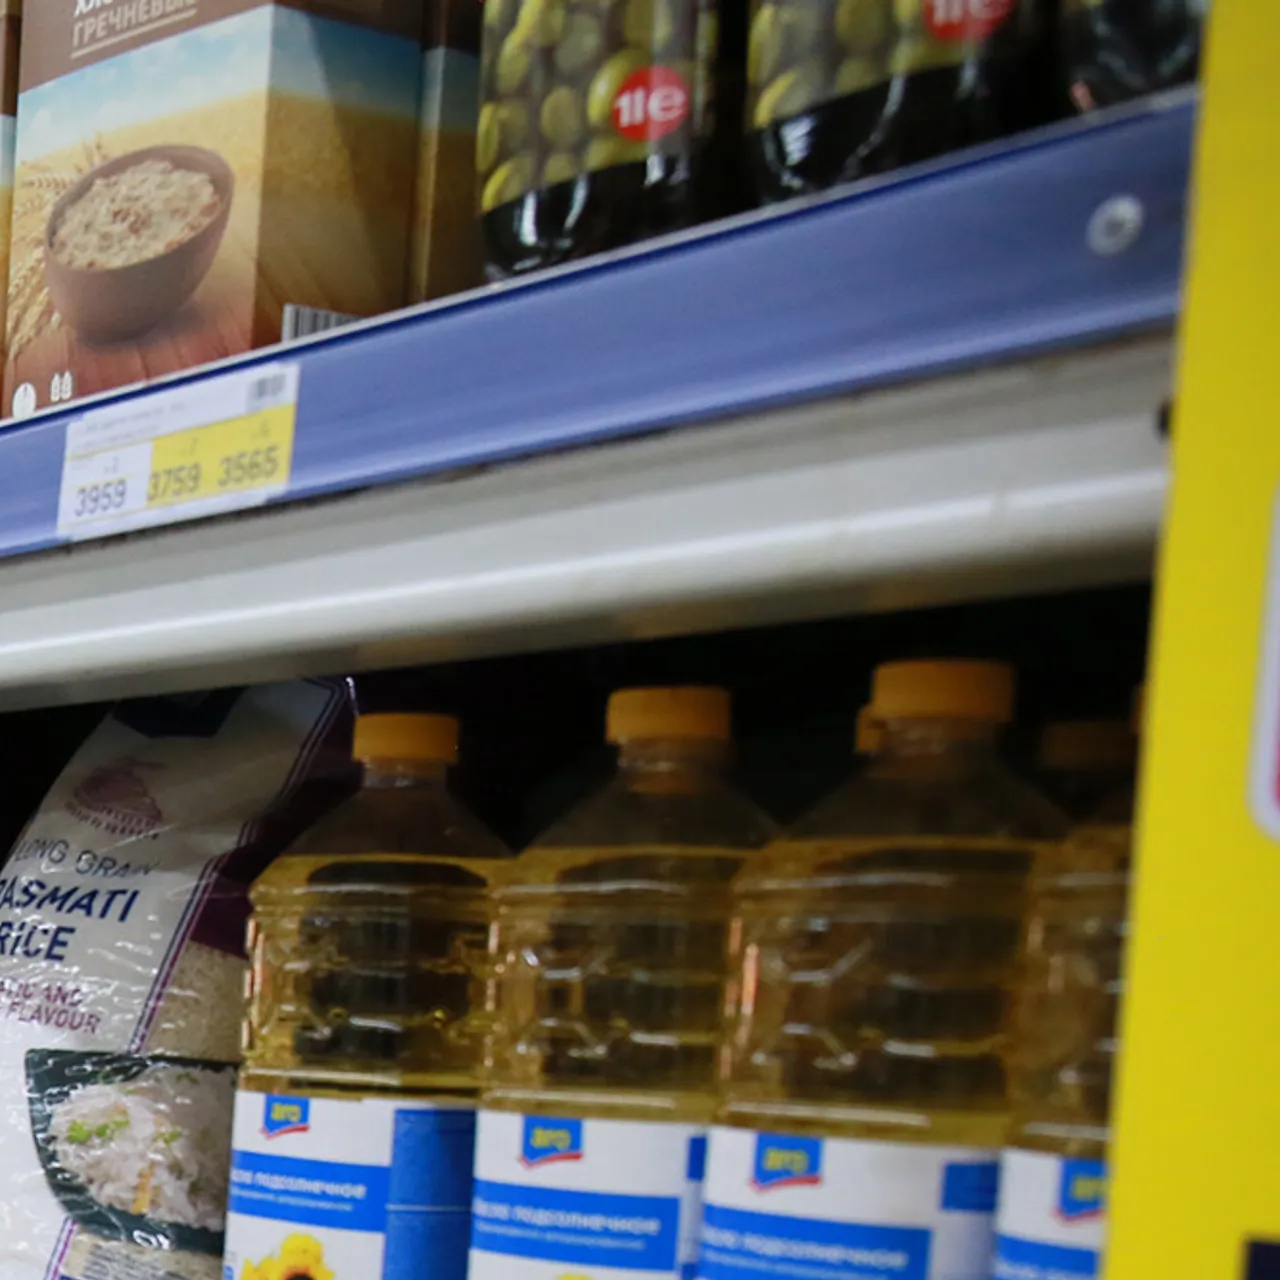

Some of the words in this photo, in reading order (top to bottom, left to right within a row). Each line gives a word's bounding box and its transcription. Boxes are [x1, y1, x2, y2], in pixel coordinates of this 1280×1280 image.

[74, 480, 128, 517] 3959
[147, 462, 203, 501] 3759
[217, 446, 281, 487] 3565
